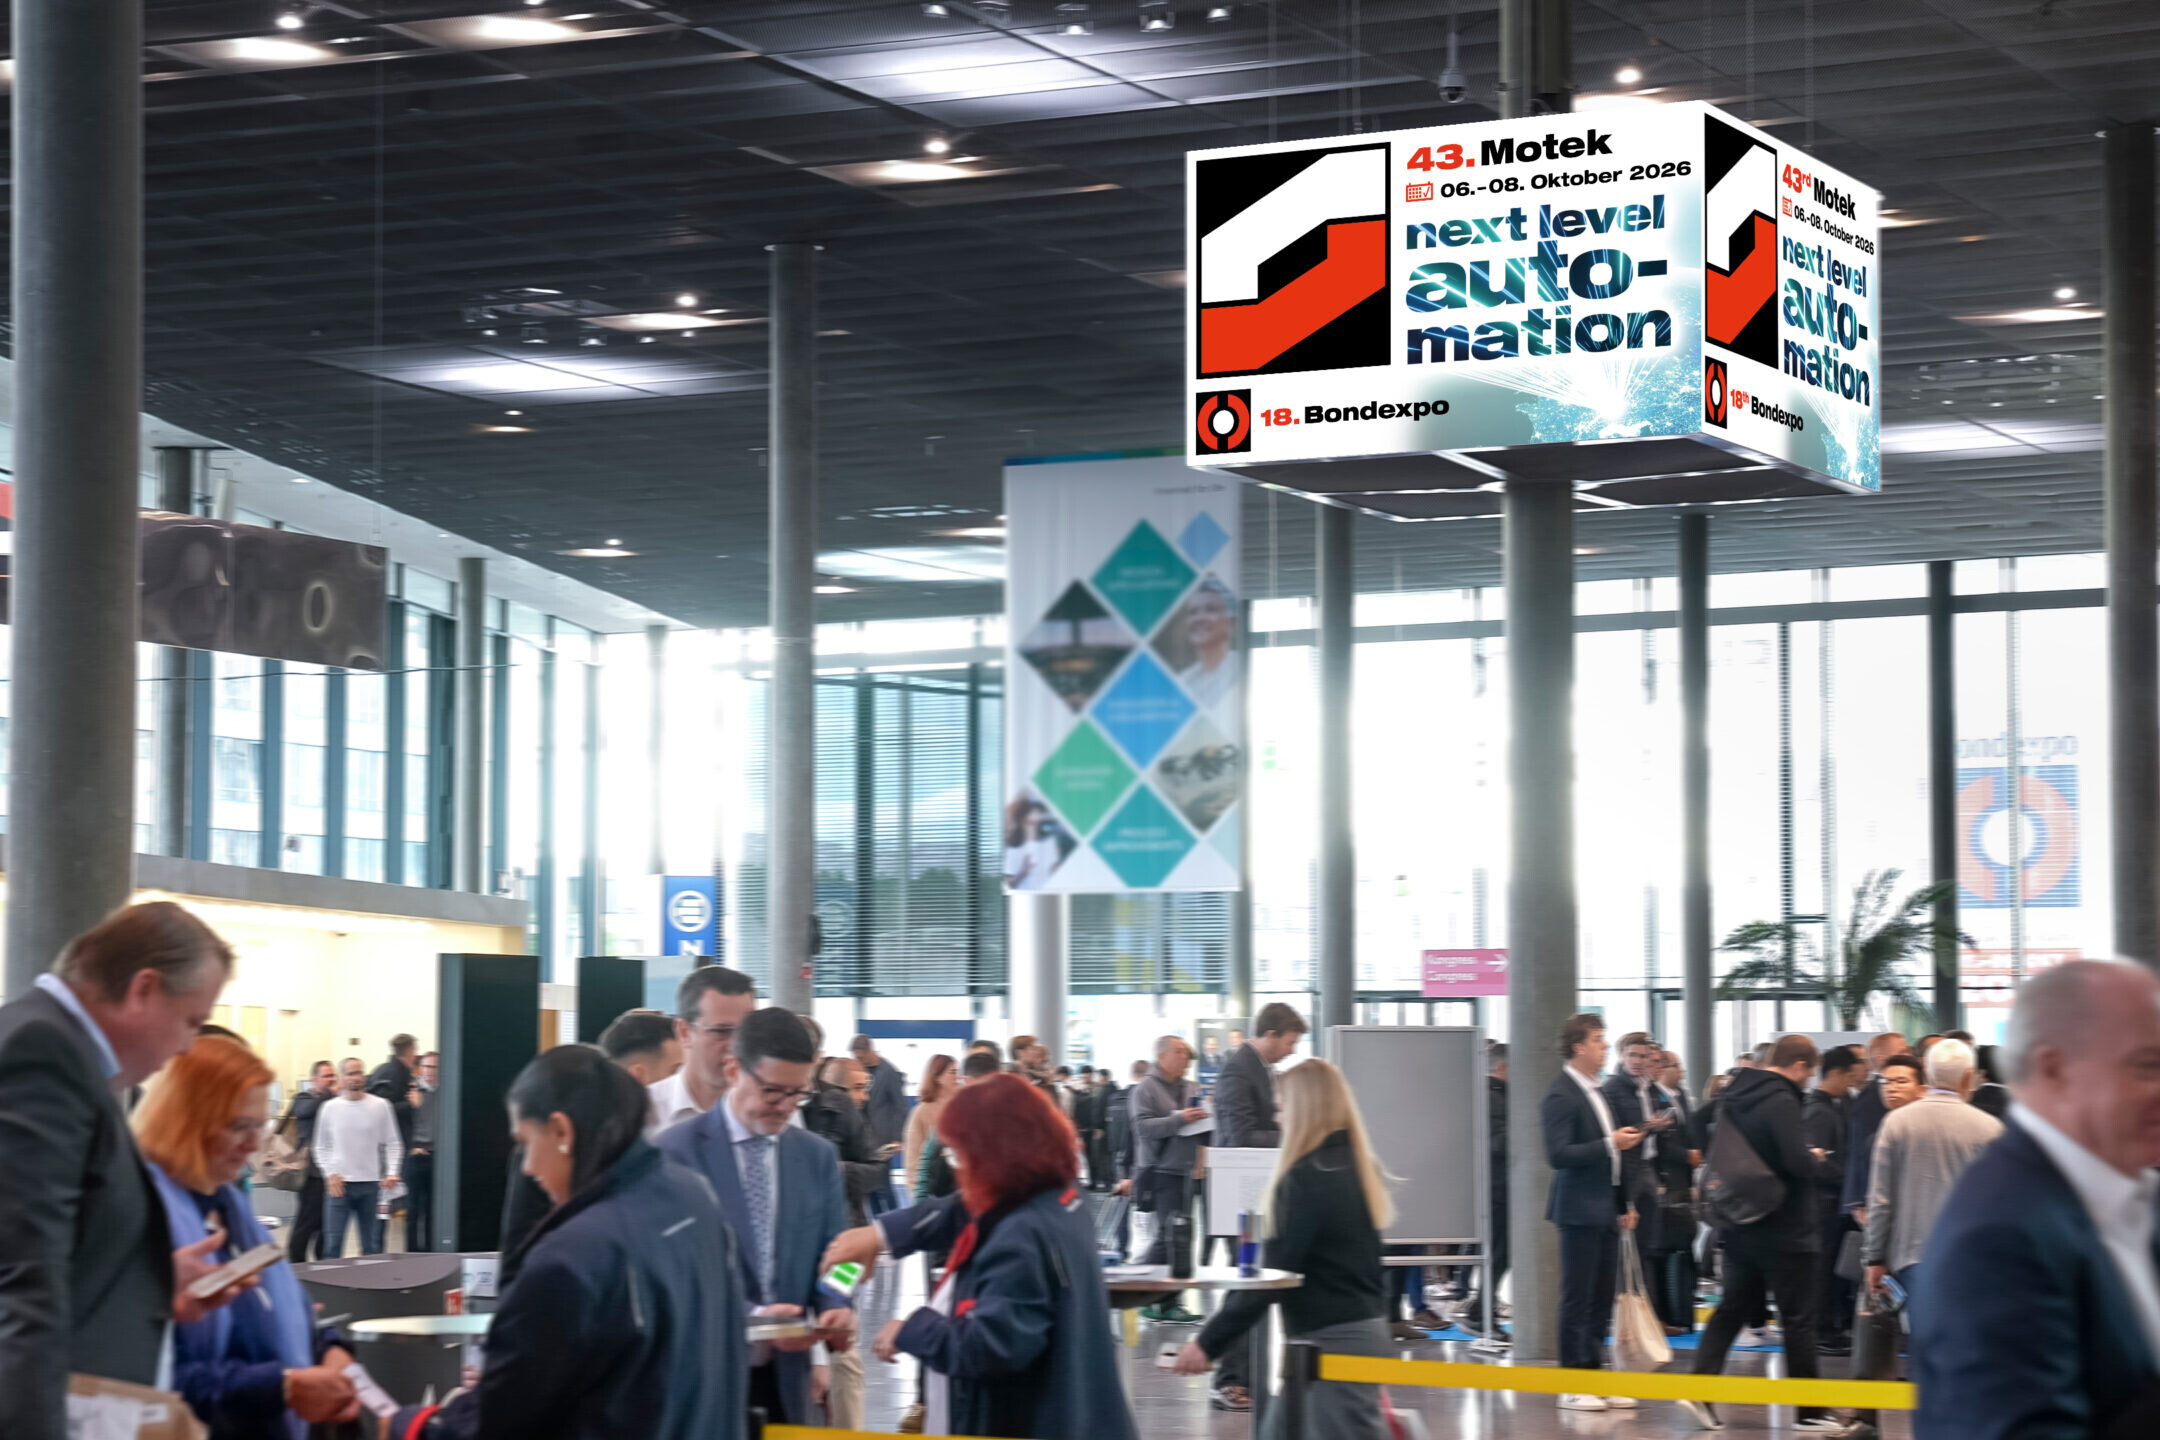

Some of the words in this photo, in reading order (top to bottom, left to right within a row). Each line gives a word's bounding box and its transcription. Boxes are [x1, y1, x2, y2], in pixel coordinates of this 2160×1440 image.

[1406, 143, 1475, 171] 43.
[1481, 129, 1613, 166] Motek
[1531, 169, 1622, 190] Oktober
[1630, 161, 1692, 181] 2026
[1782, 163, 1812, 194] 43rd
[1813, 176, 1857, 221] Motek
[1406, 207, 1527, 250] next
[1539, 194, 1665, 238] level
[1824, 219, 1854, 245] October
[1855, 234, 1875, 256] 2026
[1405, 240, 1668, 313] auto-
[1783, 235, 1824, 279] next
[1827, 249, 1867, 298] level
[1407, 304, 1672, 365] mation
[1783, 278, 1868, 351] auto-
[1784, 338, 1870, 407] mation
[1260, 408, 1300, 427] 18.
[1304, 400, 1450, 425] Bondexpo
[1730, 388, 1750, 410] 18th
[1751, 395, 1804, 433] Bondexpo
